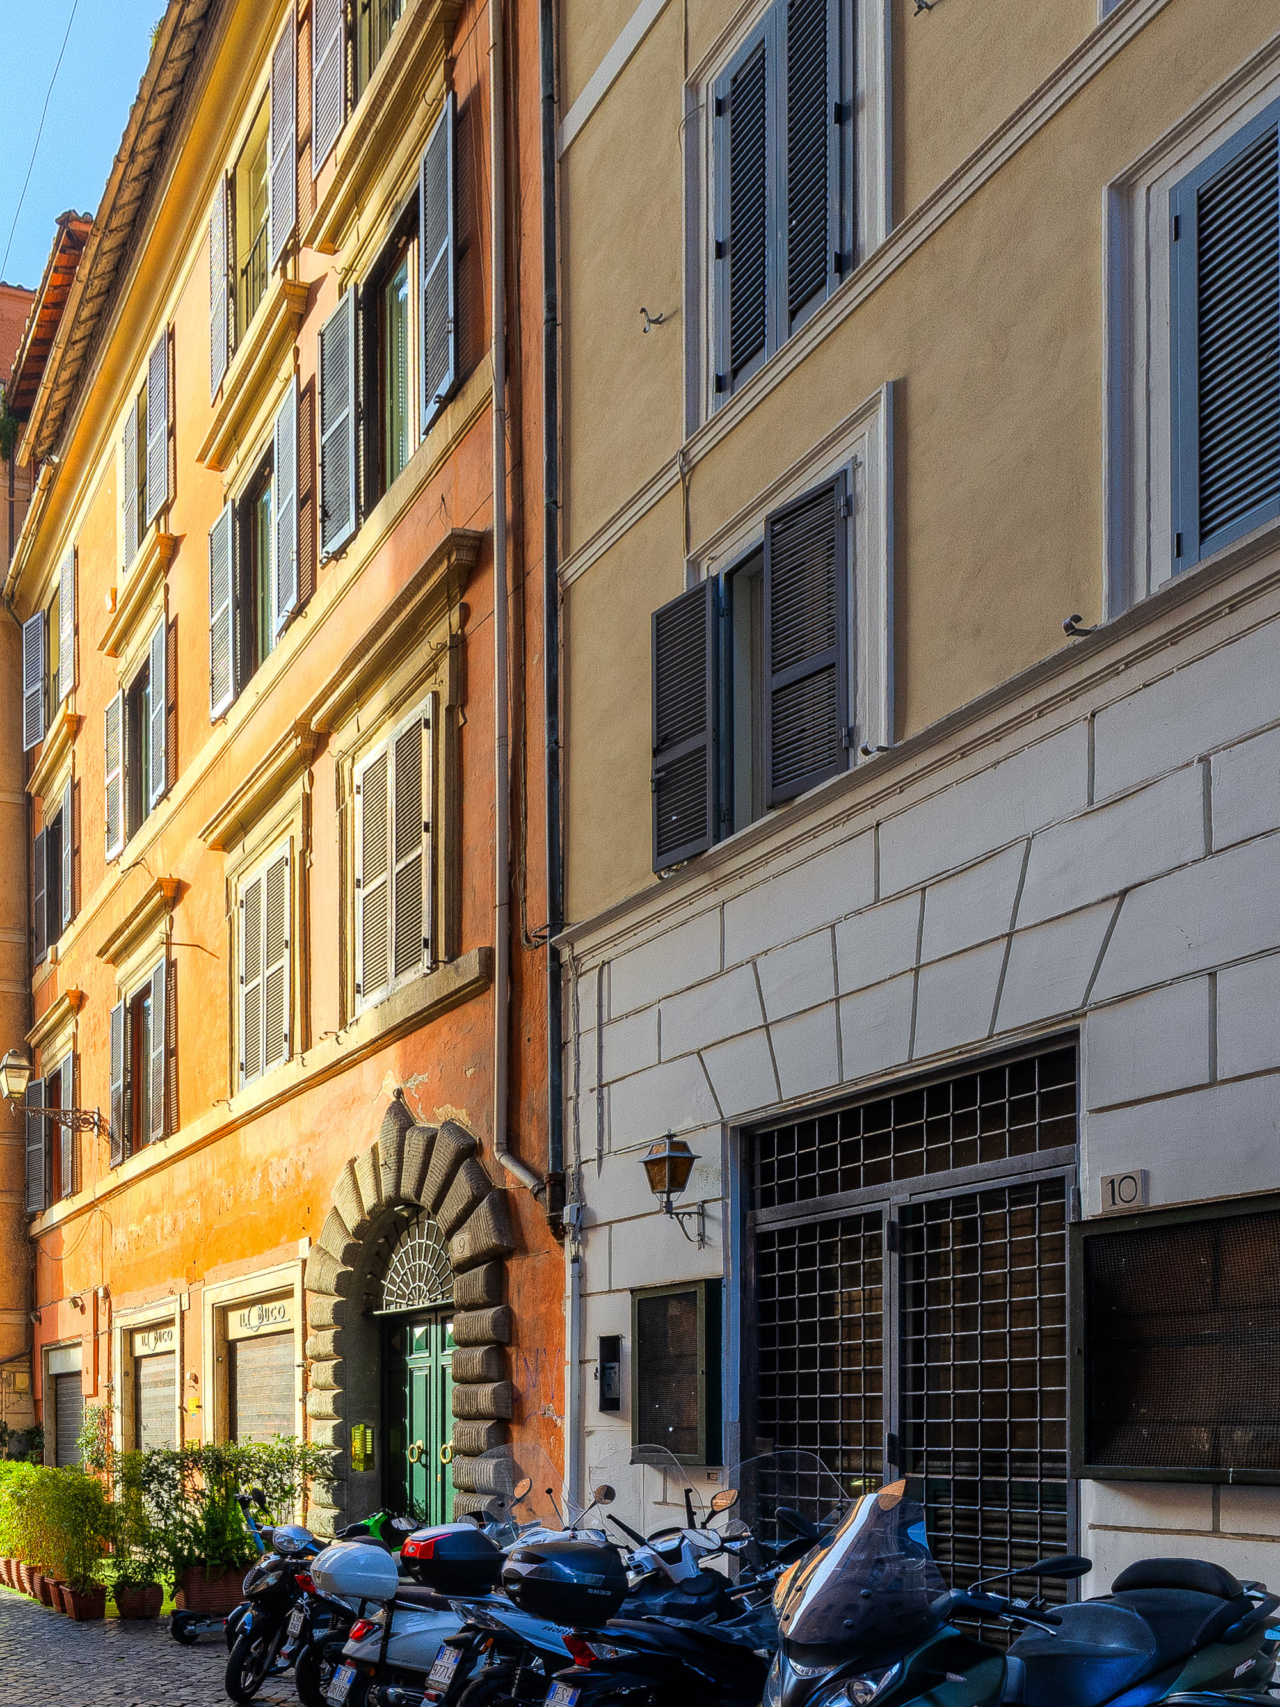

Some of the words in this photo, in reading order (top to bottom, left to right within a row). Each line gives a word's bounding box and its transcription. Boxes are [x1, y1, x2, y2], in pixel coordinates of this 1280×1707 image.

[1106, 1175, 1138, 1206] 10
[458, 1237, 466, 1255] 9
[240, 1312, 248, 1328] IL
[141, 1334, 148, 1347] IL
[431, 1664, 456, 1680] 97714
[553, 1686, 568, 1702] FS
